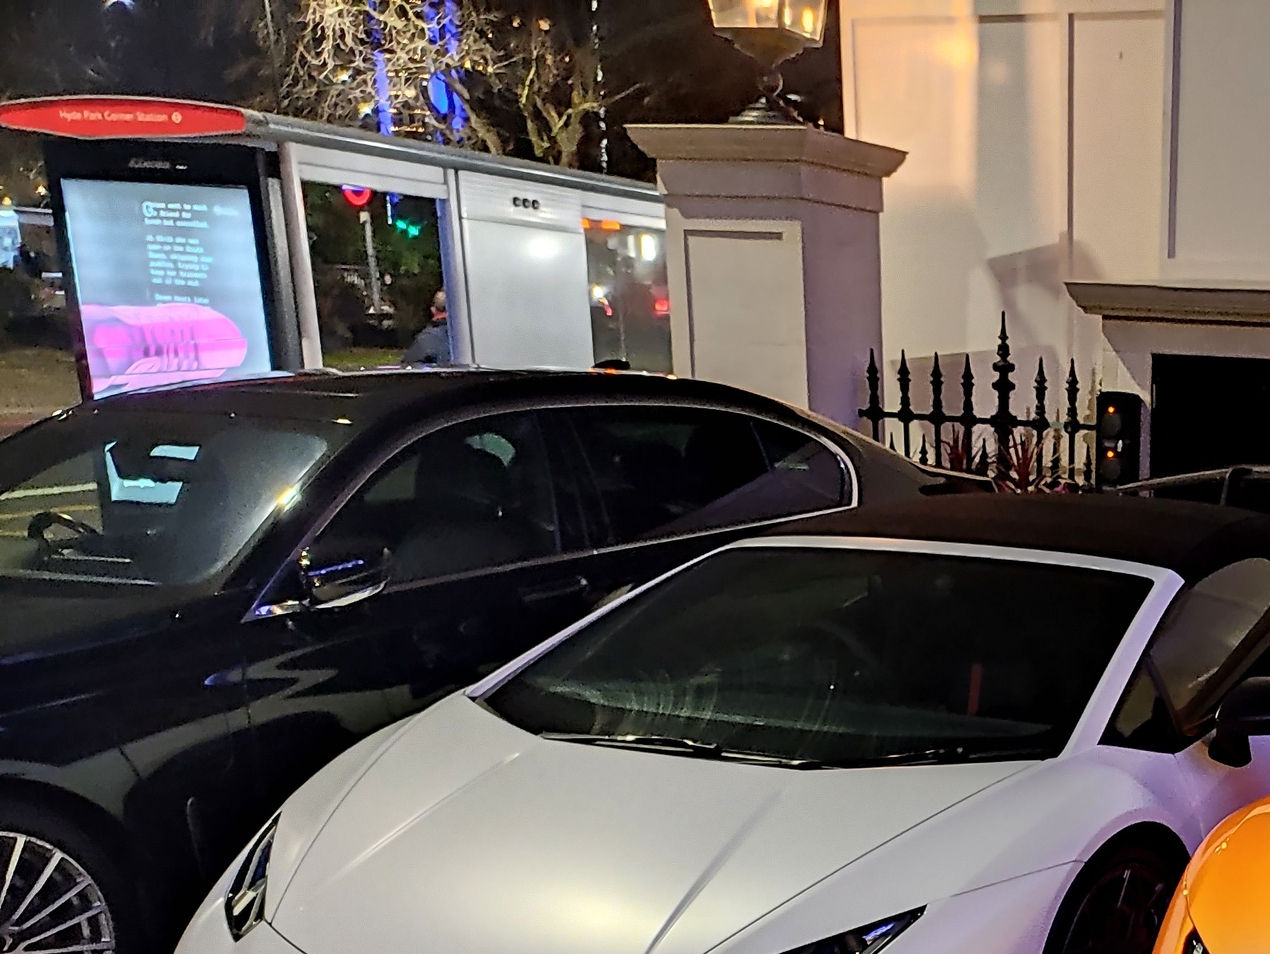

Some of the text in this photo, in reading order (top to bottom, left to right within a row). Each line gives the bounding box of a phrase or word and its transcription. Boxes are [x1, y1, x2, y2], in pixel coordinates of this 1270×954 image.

[59, 110, 168, 122] Hyde Park Corner Station
